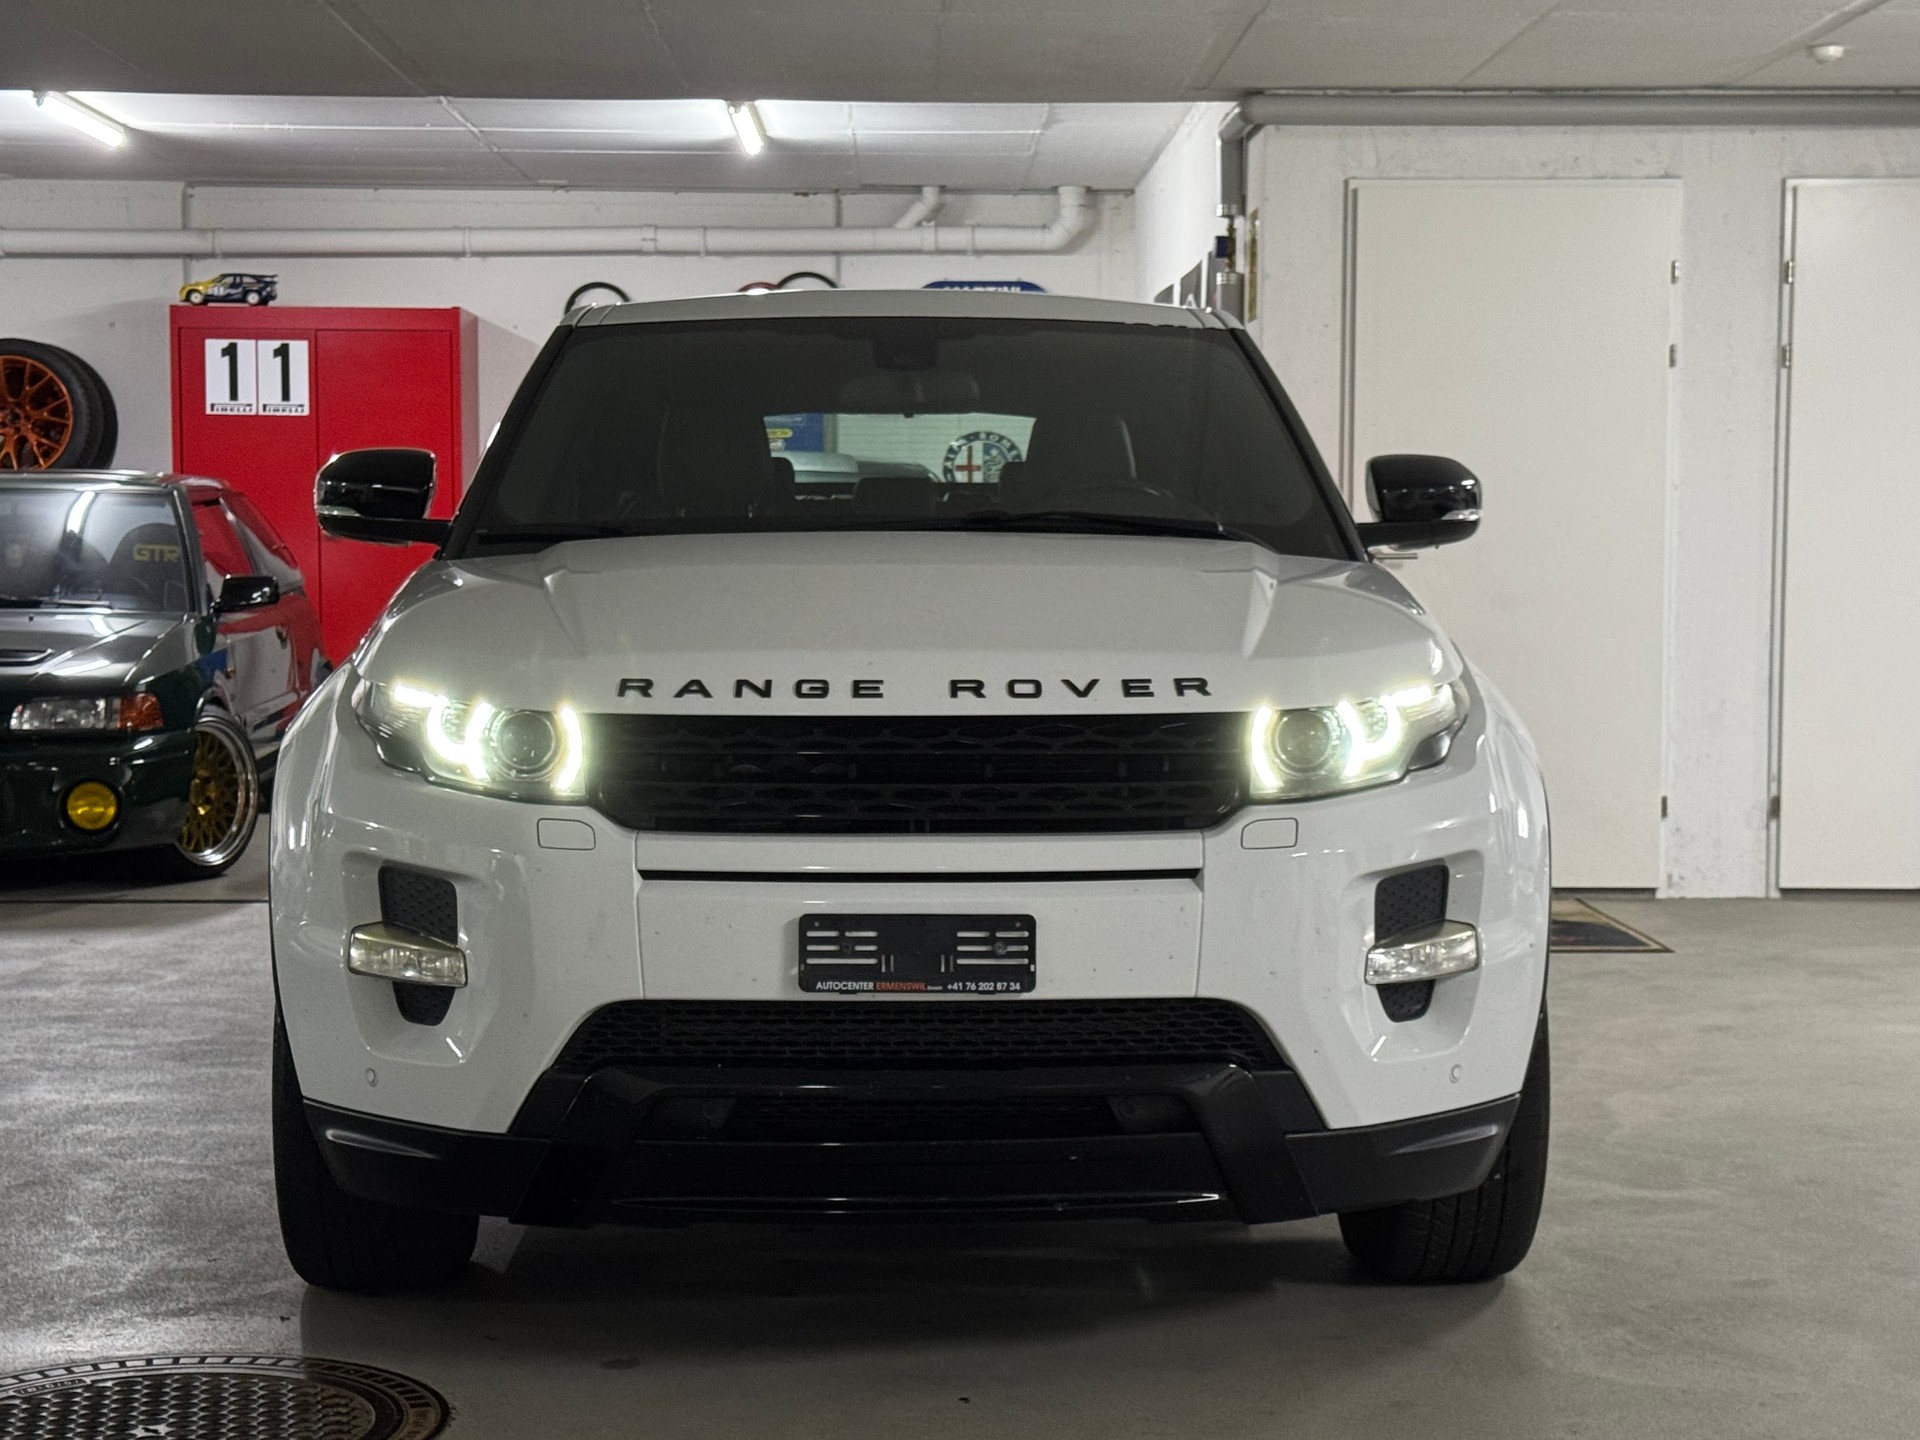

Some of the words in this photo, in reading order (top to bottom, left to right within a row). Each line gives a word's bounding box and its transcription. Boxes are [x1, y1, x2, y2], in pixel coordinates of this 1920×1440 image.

[616, 678, 885, 699] RANGE
[949, 677, 1213, 699] ROVER
[815, 981, 874, 991] AUTOCENTER
[876, 982, 926, 991] ERMENSWIL
[947, 982, 963, 991] +41
[965, 982, 977, 991] 76
[978, 982, 995, 991] 202
[1009, 982, 1021, 991] 34
